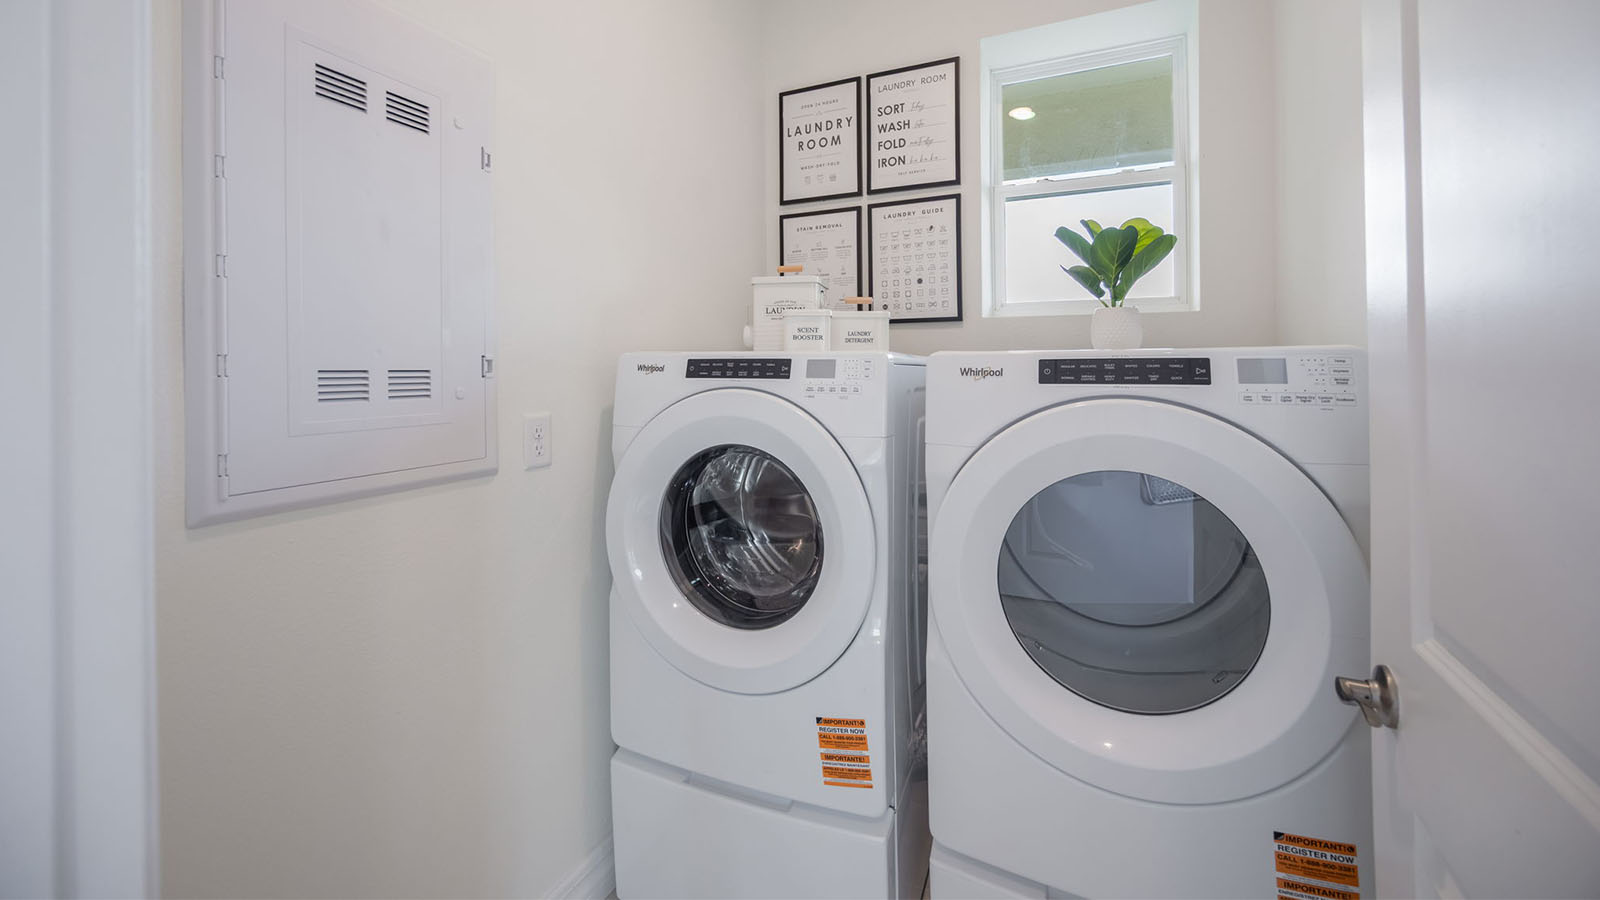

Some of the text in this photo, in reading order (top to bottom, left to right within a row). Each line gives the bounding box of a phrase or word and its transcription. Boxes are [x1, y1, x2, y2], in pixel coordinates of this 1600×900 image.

[877, 73, 947, 93] LAUNDRY ROOM
[877, 103, 905, 117] SORT
[787, 116, 853, 138] LAUNDRY
[877, 119, 911, 134] WASH
[798, 135, 842, 152] ROOM
[877, 138, 906, 151] FOLD
[877, 155, 906, 169] IRON
[883, 211, 917, 220] LAUNDRY
[920, 207, 944, 216] GUIDE
[797, 327, 820, 335] SCENT
[637, 363, 665, 374] Whirlpool
[960, 367, 1003, 379] Whirlpool
[823, 718, 860, 727] IMPORTANT!
[819, 726, 849, 735] REGISTER
[824, 754, 865, 763] IMPORTANTE!
[1285, 835, 1347, 852] IMPORTANT!
[1277, 844, 1355, 865] REGISTER NOW
[1277, 853, 1298, 864] CALL
[1283, 881, 1353, 900] IMPORTANTE!
